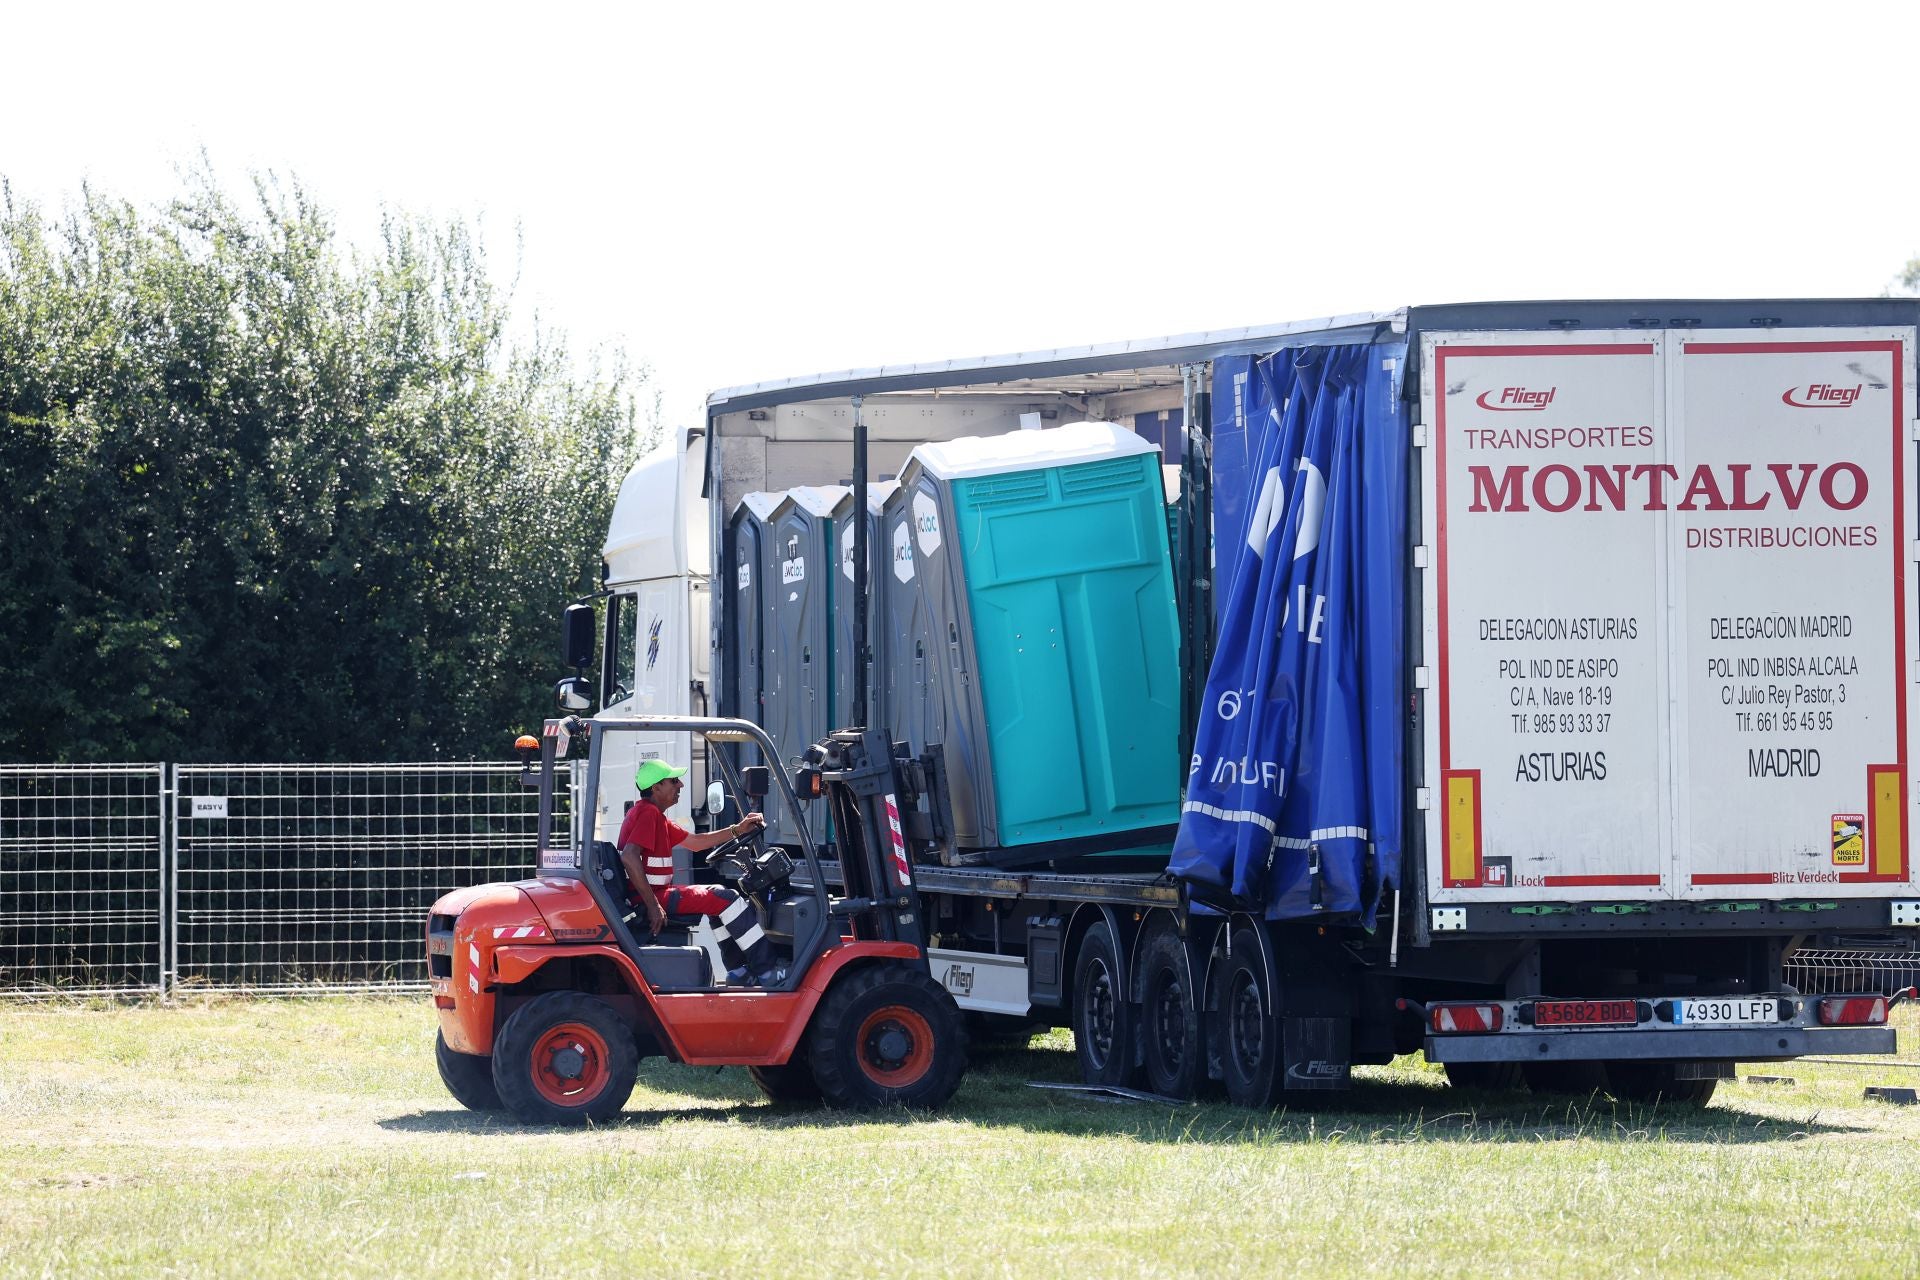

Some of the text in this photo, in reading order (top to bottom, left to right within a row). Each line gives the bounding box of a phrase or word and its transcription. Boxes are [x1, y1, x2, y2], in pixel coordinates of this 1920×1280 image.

[1500, 387, 1556, 410] Fliegl
[1806, 384, 1862, 408] Fliegl
[1464, 426, 1653, 449] TRANSPORTES
[1468, 462, 1869, 512] MONTALVO
[1686, 526, 1877, 548] DISTRIBUCIONES
[1480, 618, 1637, 640] DELEGACION ASTURIAS
[1711, 616, 1851, 639] DELEGACION MADRID
[1500, 659, 1618, 679] POL IND DE ASIPO
[1709, 656, 1858, 678] POL IND INBISA ALCALA
[1511, 686, 1612, 708] C/ A, Nave 18-19
[1722, 684, 1846, 707] C/ Julio Rey Pastor, 3
[1512, 713, 1611, 733] Tlf. 985 93 33 37
[1736, 712, 1833, 732] Tlf. 661 95 45 95
[1516, 751, 1607, 782] ASTURIAS
[1748, 749, 1821, 778] MADRID
[1514, 874, 1544, 887] I-Lock
[1772, 870, 1838, 884] Blitz Verdeck
[950, 964, 975, 994] Fliegl
[1686, 1002, 1773, 1020] 4930 LFP
